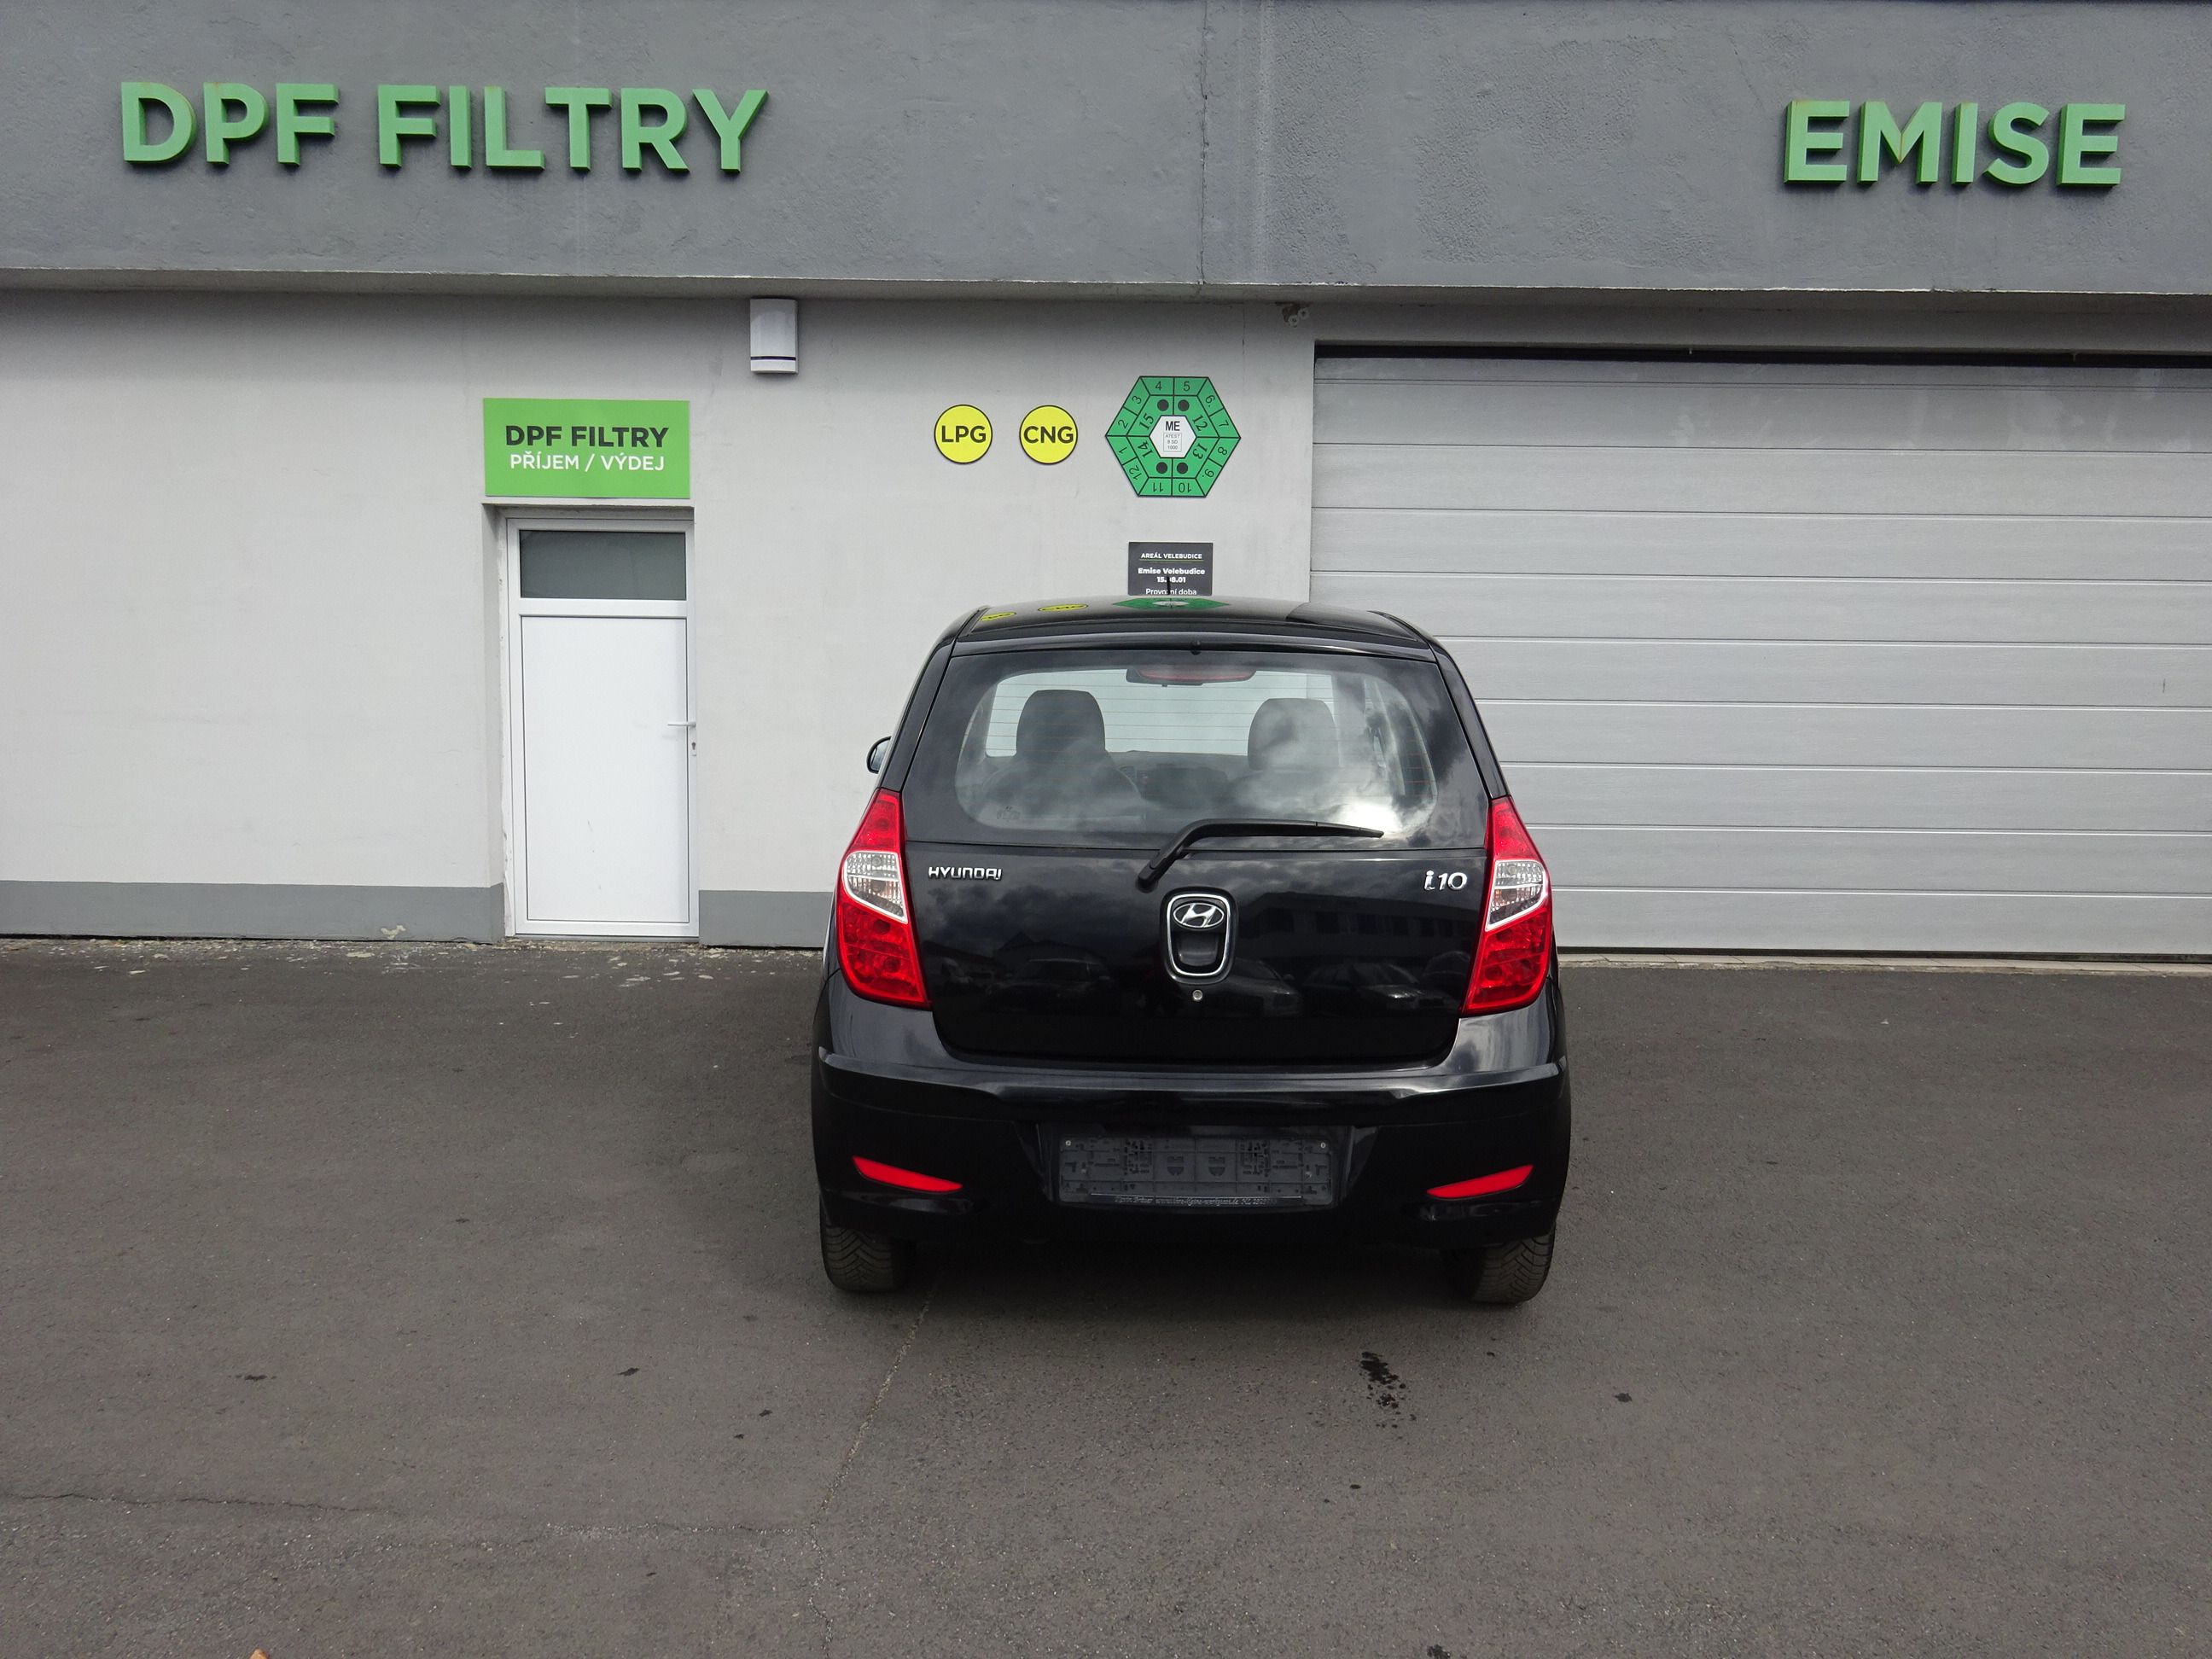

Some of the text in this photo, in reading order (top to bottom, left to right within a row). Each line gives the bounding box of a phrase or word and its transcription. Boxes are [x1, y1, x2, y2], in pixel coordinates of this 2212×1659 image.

[121, 81, 768, 173] DPF FILTRY
[1784, 100, 2126, 187] EMISE
[1155, 381, 1162, 391] 4
[1183, 381, 1190, 392] 5
[1132, 395, 1142, 405] 3
[1117, 419, 1129, 429] 2
[1138, 412, 1155, 431] 15
[1165, 421, 1180, 432] ME
[1192, 415, 1208, 432] 12
[1218, 419, 1230, 428] 7
[505, 425, 669, 448] DPF FILTRY
[941, 425, 987, 444] LPG
[1023, 426, 1074, 444] CNG
[1137, 439, 1154, 458] 14
[1192, 443, 1208, 460] 13
[1217, 446, 1228, 456] 8
[509, 451, 665, 473] PŘÍJEM / VÝDEJ
[1128, 464, 1142, 480] 12
[1152, 481, 1164, 492] 11
[1178, 482, 1192, 493] 10
[1138, 567, 1161, 575] Emise
[928, 866, 1002, 881] HYUNDAI
[1424, 870, 1468, 891] i10
